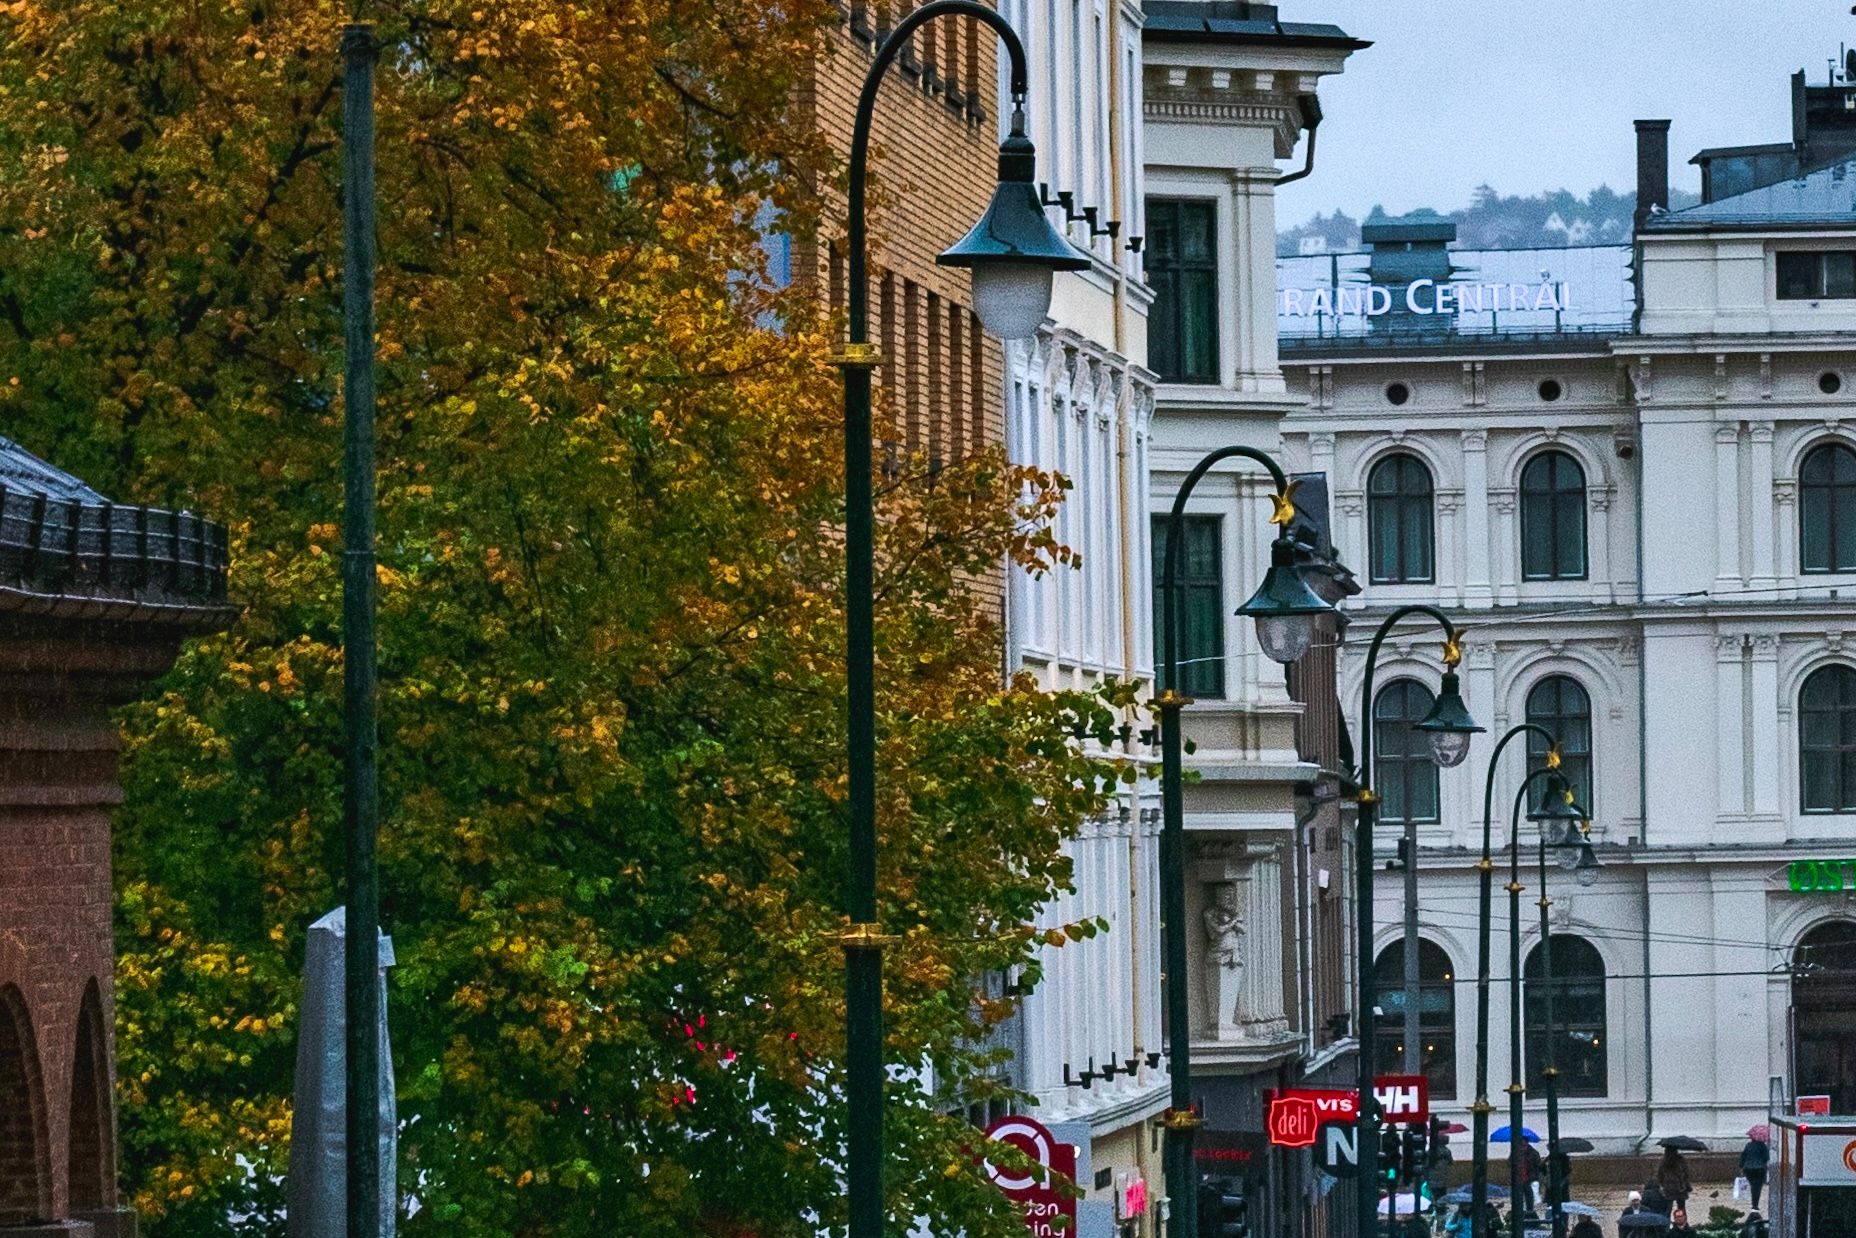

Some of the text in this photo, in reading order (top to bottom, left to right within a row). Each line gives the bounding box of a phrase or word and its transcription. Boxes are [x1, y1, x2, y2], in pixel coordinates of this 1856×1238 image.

[1283, 277, 1581, 317] RAND CENTRAL
[1316, 1097, 1353, 1112] VI'S
[1277, 1105, 1307, 1136] deli
